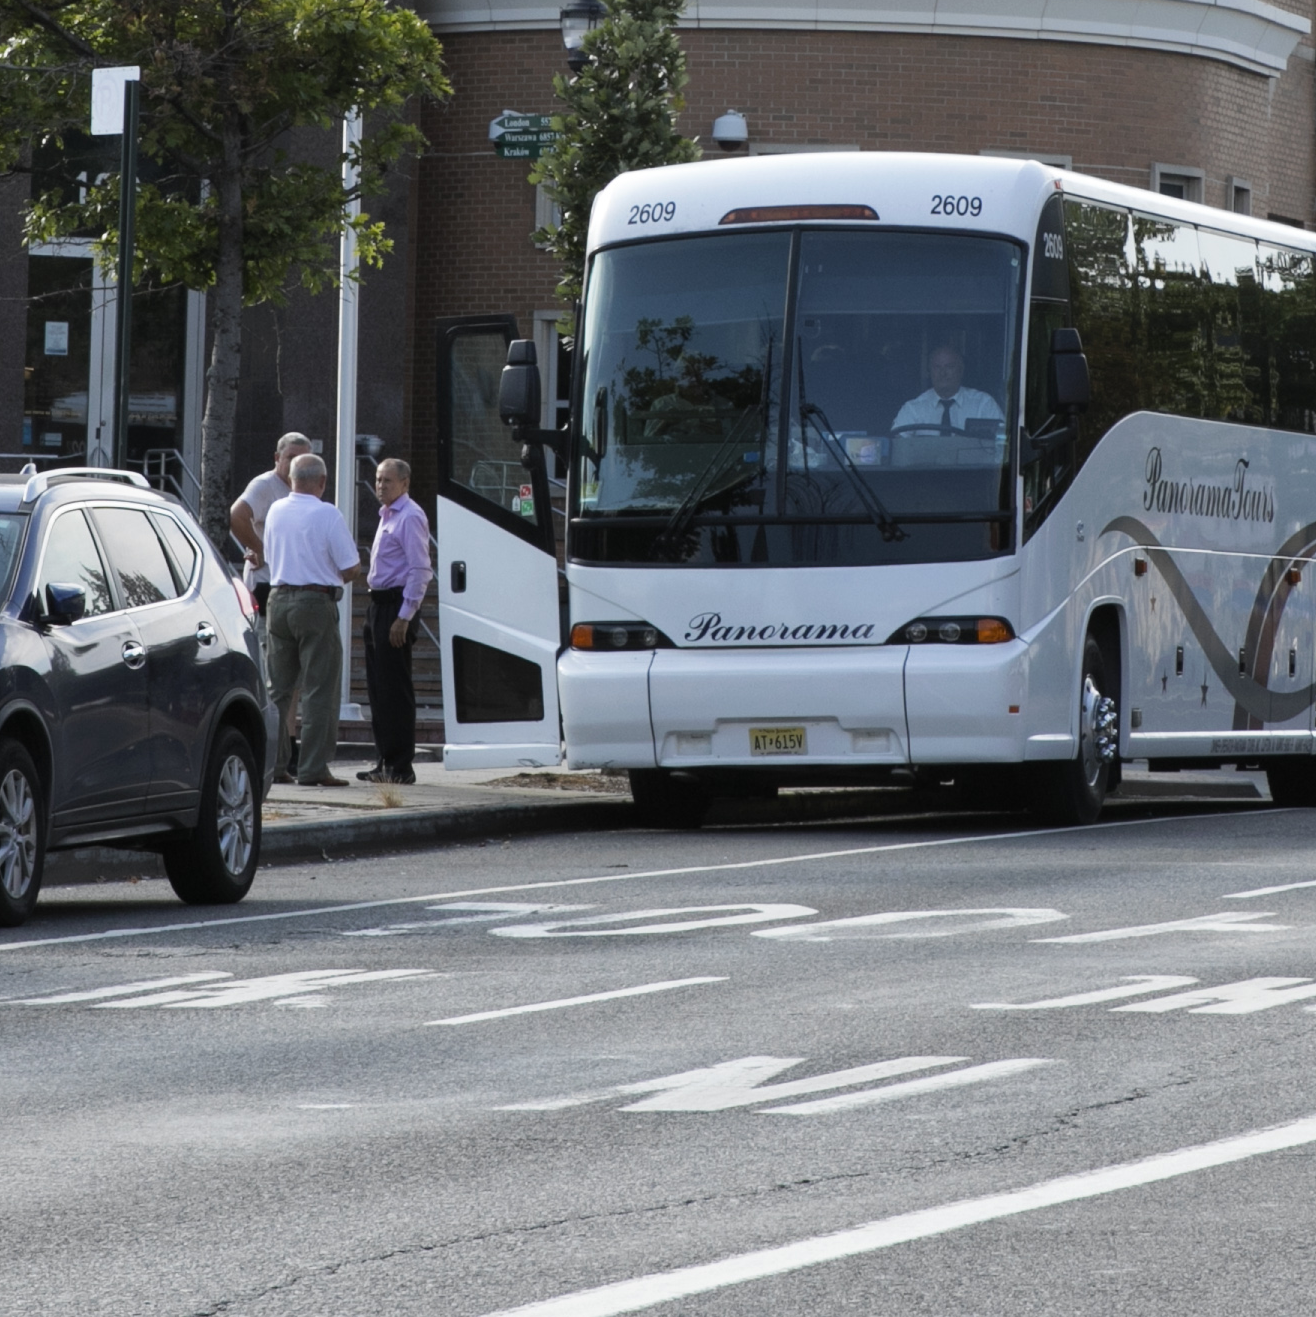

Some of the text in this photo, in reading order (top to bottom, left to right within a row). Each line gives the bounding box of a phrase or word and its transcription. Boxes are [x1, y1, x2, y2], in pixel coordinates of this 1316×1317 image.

[505, 118, 530, 127] London
[504, 132, 537, 142] Warszawa
[503, 146, 530, 157] Kraków
[628, 201, 676, 224] 2609
[930, 195, 983, 217] 2609
[1043, 231, 1064, 260] 2609
[1143, 446, 1233, 518] Panorama
[684, 611, 876, 642] Panorama
